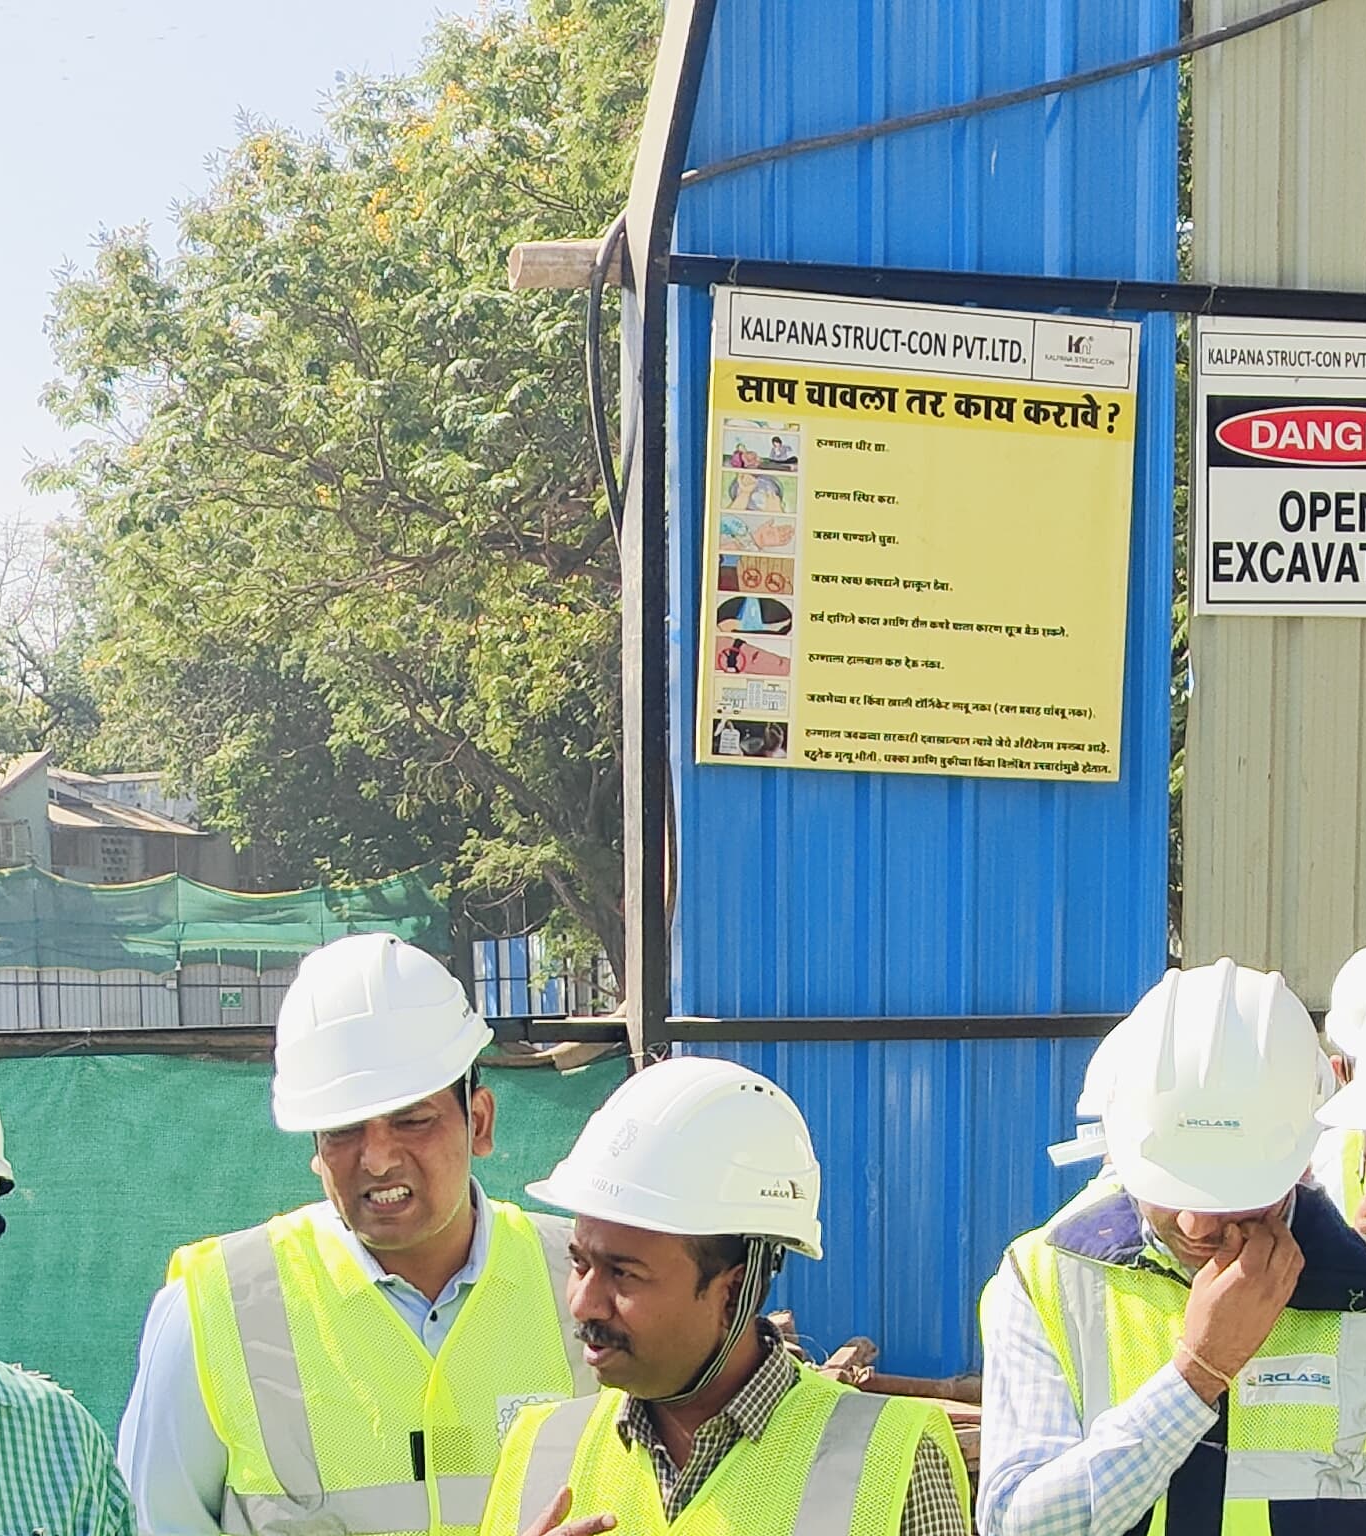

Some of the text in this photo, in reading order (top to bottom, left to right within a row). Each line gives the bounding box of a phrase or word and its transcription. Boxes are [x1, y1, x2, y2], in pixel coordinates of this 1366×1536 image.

[740, 315, 827, 348] KALPANA
[832, 323, 946, 357] STRUCT-CON
[1208, 347, 1263, 366] KALPANA
[1266, 350, 1341, 368] STRUCT-CON
[737, 373, 797, 404] साप
[806, 380, 897, 413] चावला
[906, 388, 946, 418] तर
[954, 393, 1014, 422] काय
[1024, 394, 1101, 429] करावे
[1258, 1372, 1332, 1386] IRCLASS
